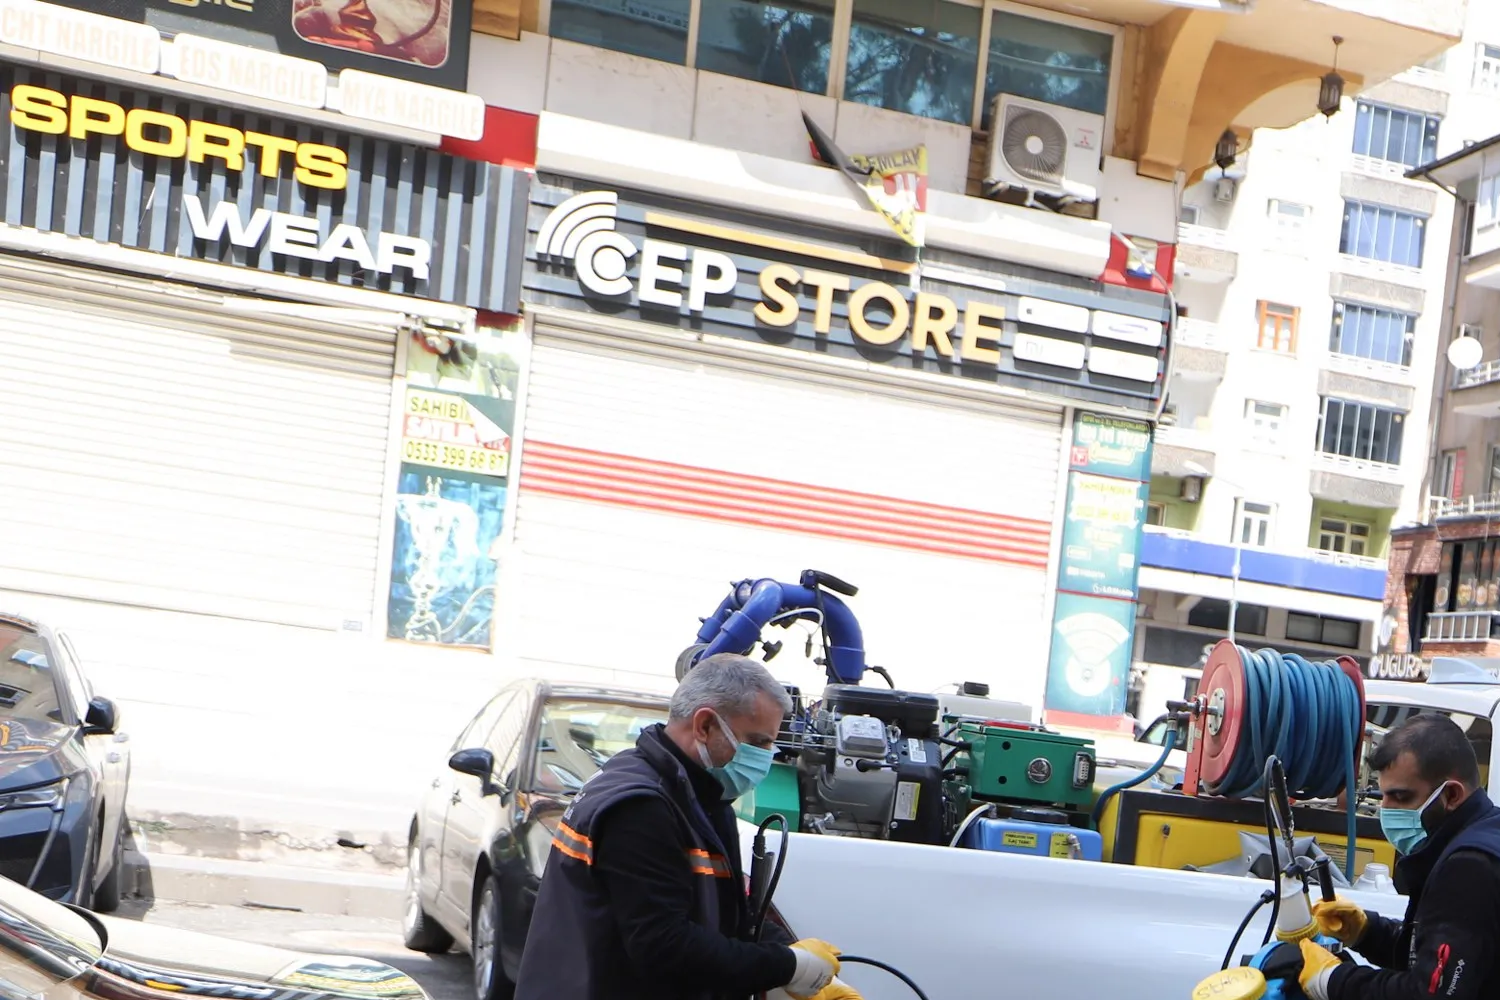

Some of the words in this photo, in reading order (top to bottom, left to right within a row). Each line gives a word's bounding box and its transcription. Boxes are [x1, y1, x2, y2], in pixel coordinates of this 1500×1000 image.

[179, 44, 222, 82] EDS
[228, 54, 322, 104] NARGILE
[11, 84, 349, 190] SPORTS
[183, 194, 432, 281] WEAR
[560, 216, 738, 312] CEP
[754, 262, 1006, 365] STORE
[406, 440, 438, 463] 0533
[442, 446, 466, 467] 399
